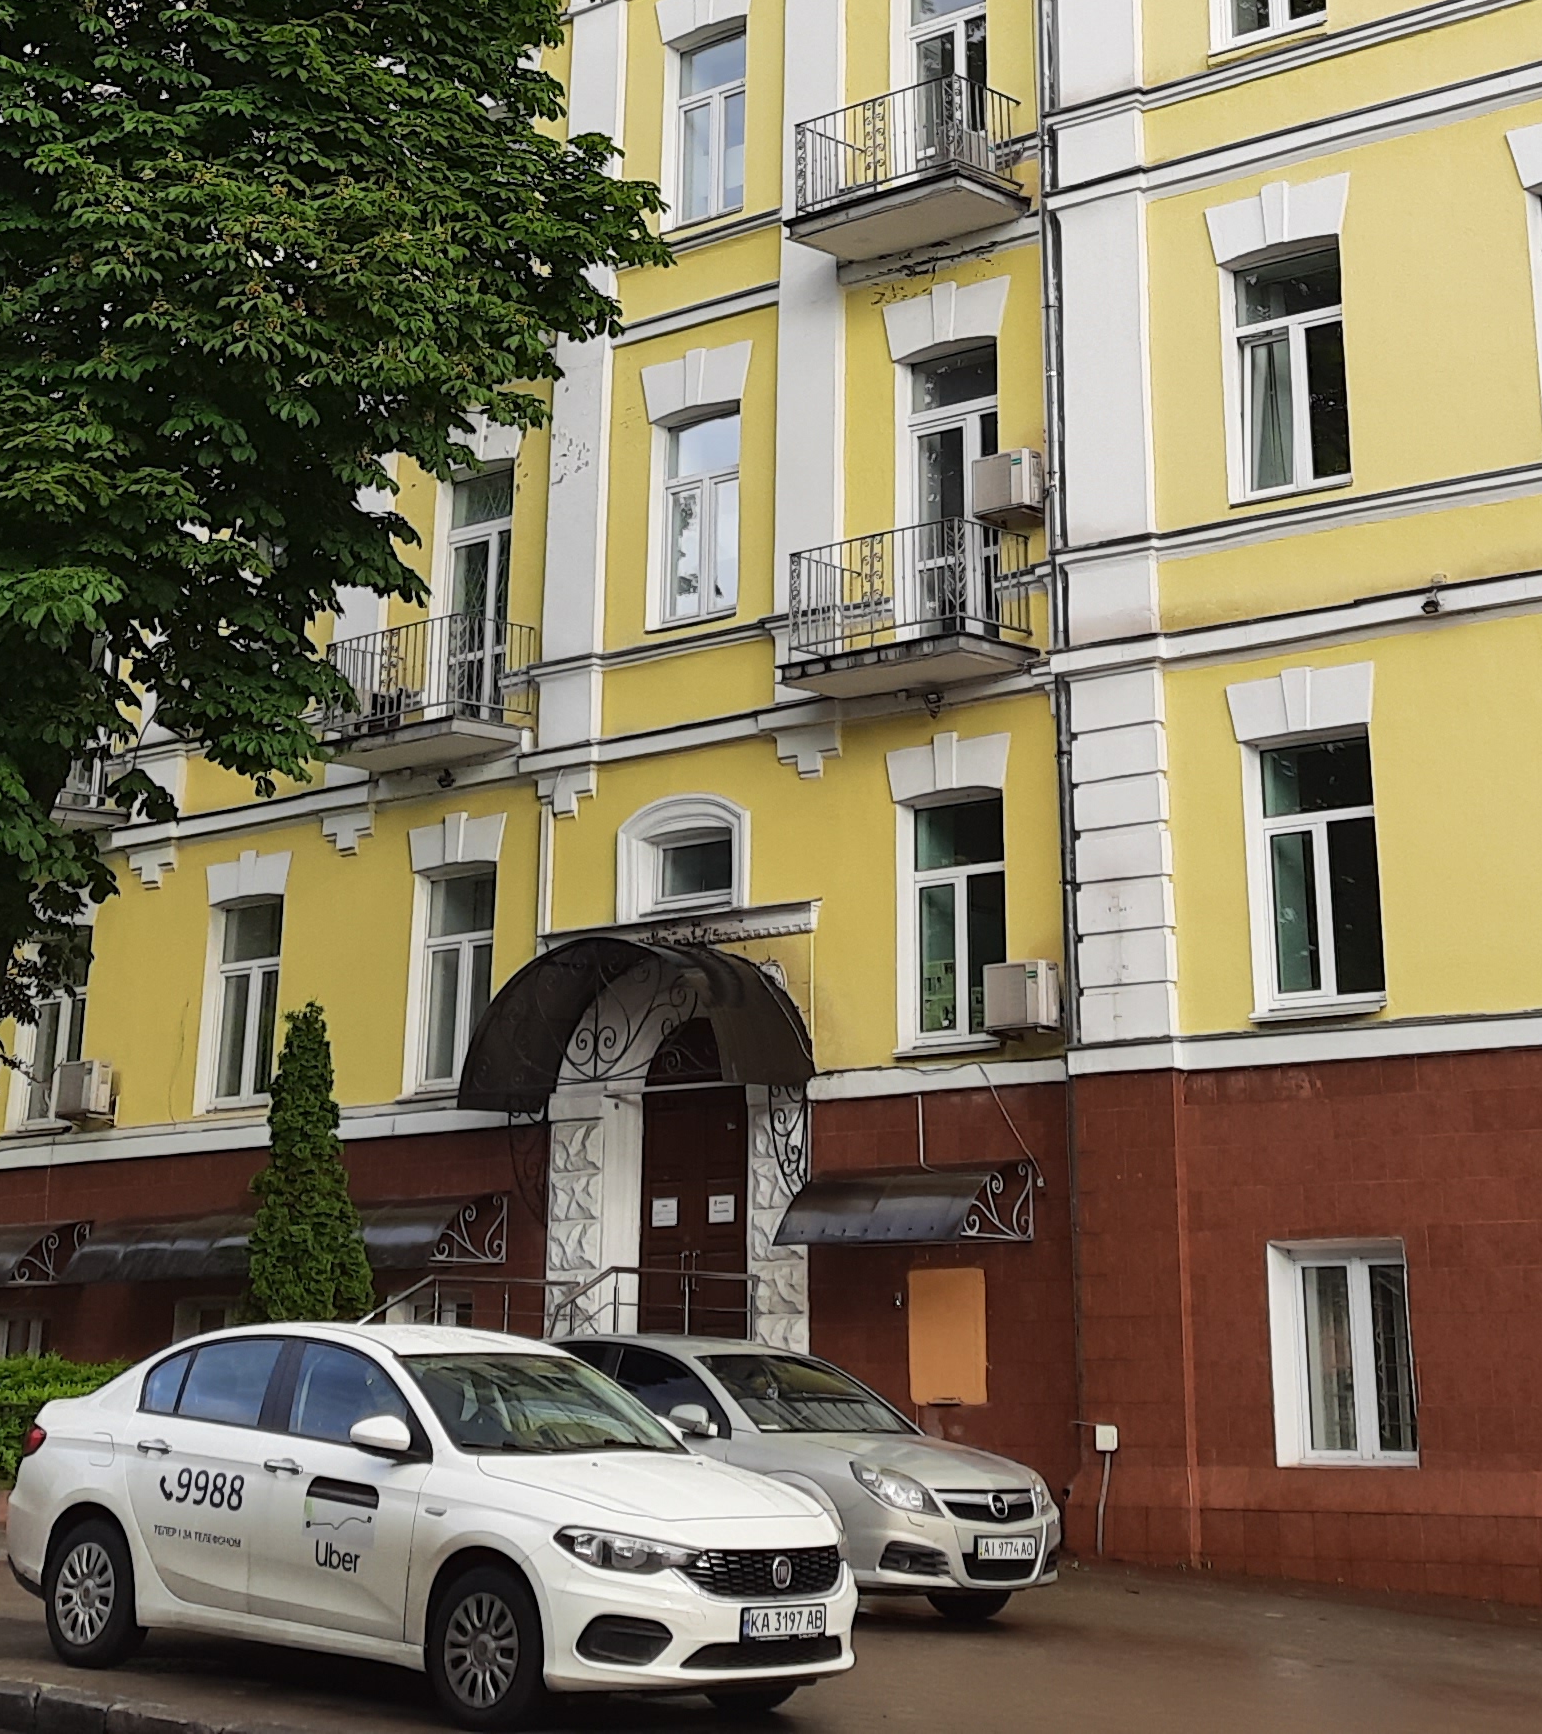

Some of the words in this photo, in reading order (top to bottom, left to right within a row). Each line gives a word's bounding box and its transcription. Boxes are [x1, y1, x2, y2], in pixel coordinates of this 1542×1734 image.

[175, 1467, 245, 1511] 9988
[315, 1539, 360, 1573] Uber
[750, 1612, 770, 1633] KA
[774, 1610, 803, 1632] 3197
[806, 1609, 823, 1630] AB
